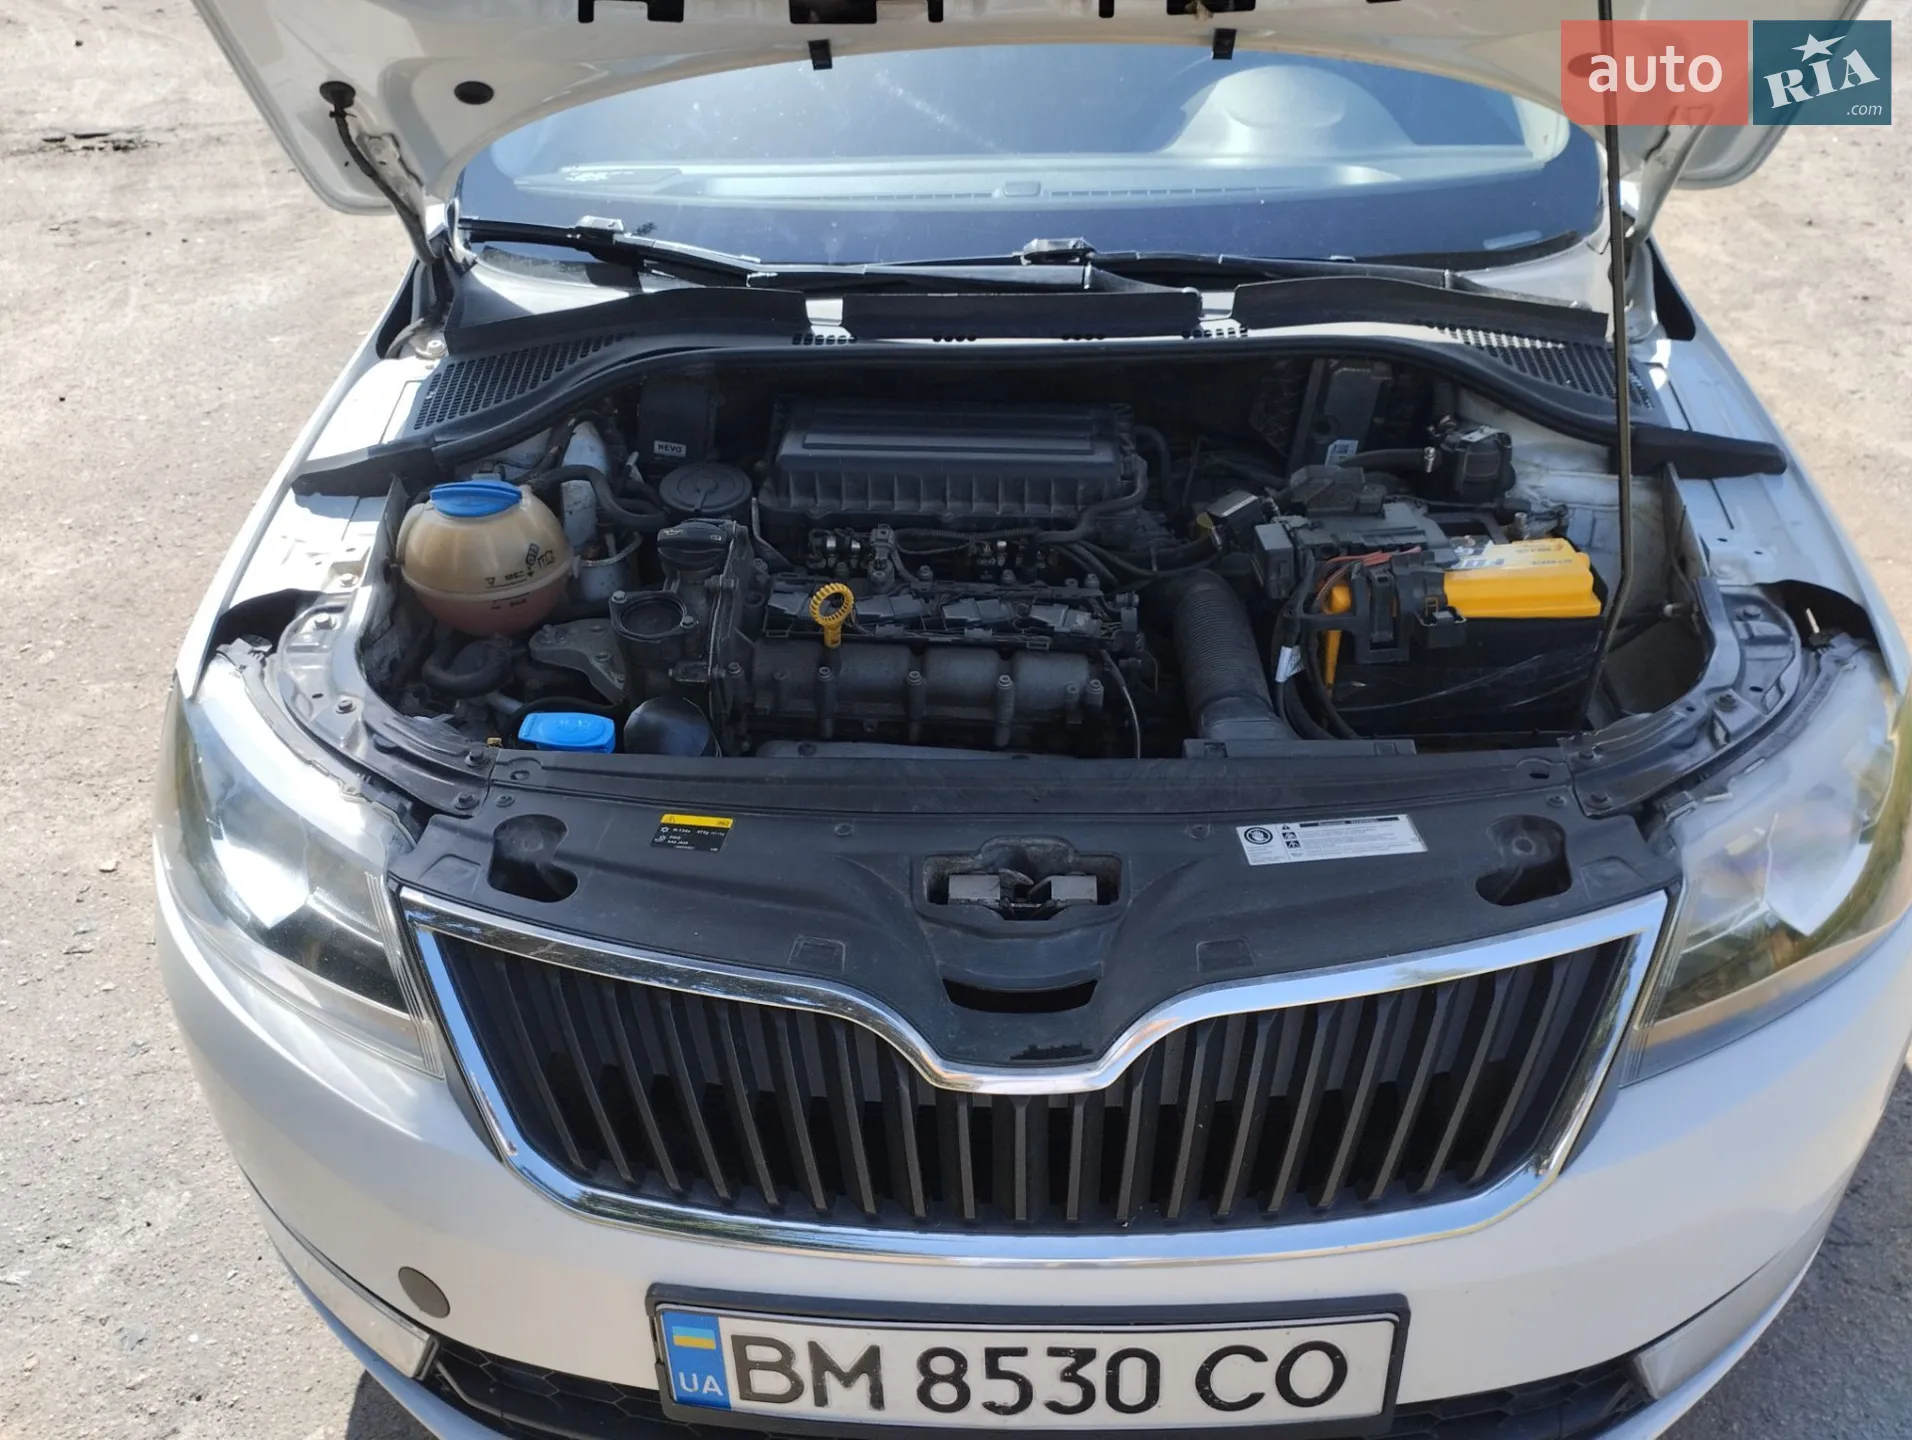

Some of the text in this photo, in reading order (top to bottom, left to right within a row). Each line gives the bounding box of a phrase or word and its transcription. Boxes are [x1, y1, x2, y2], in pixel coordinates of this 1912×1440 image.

[678, 1371, 724, 1397] UA
[731, 1333, 1348, 1415] BM 8530 CO
